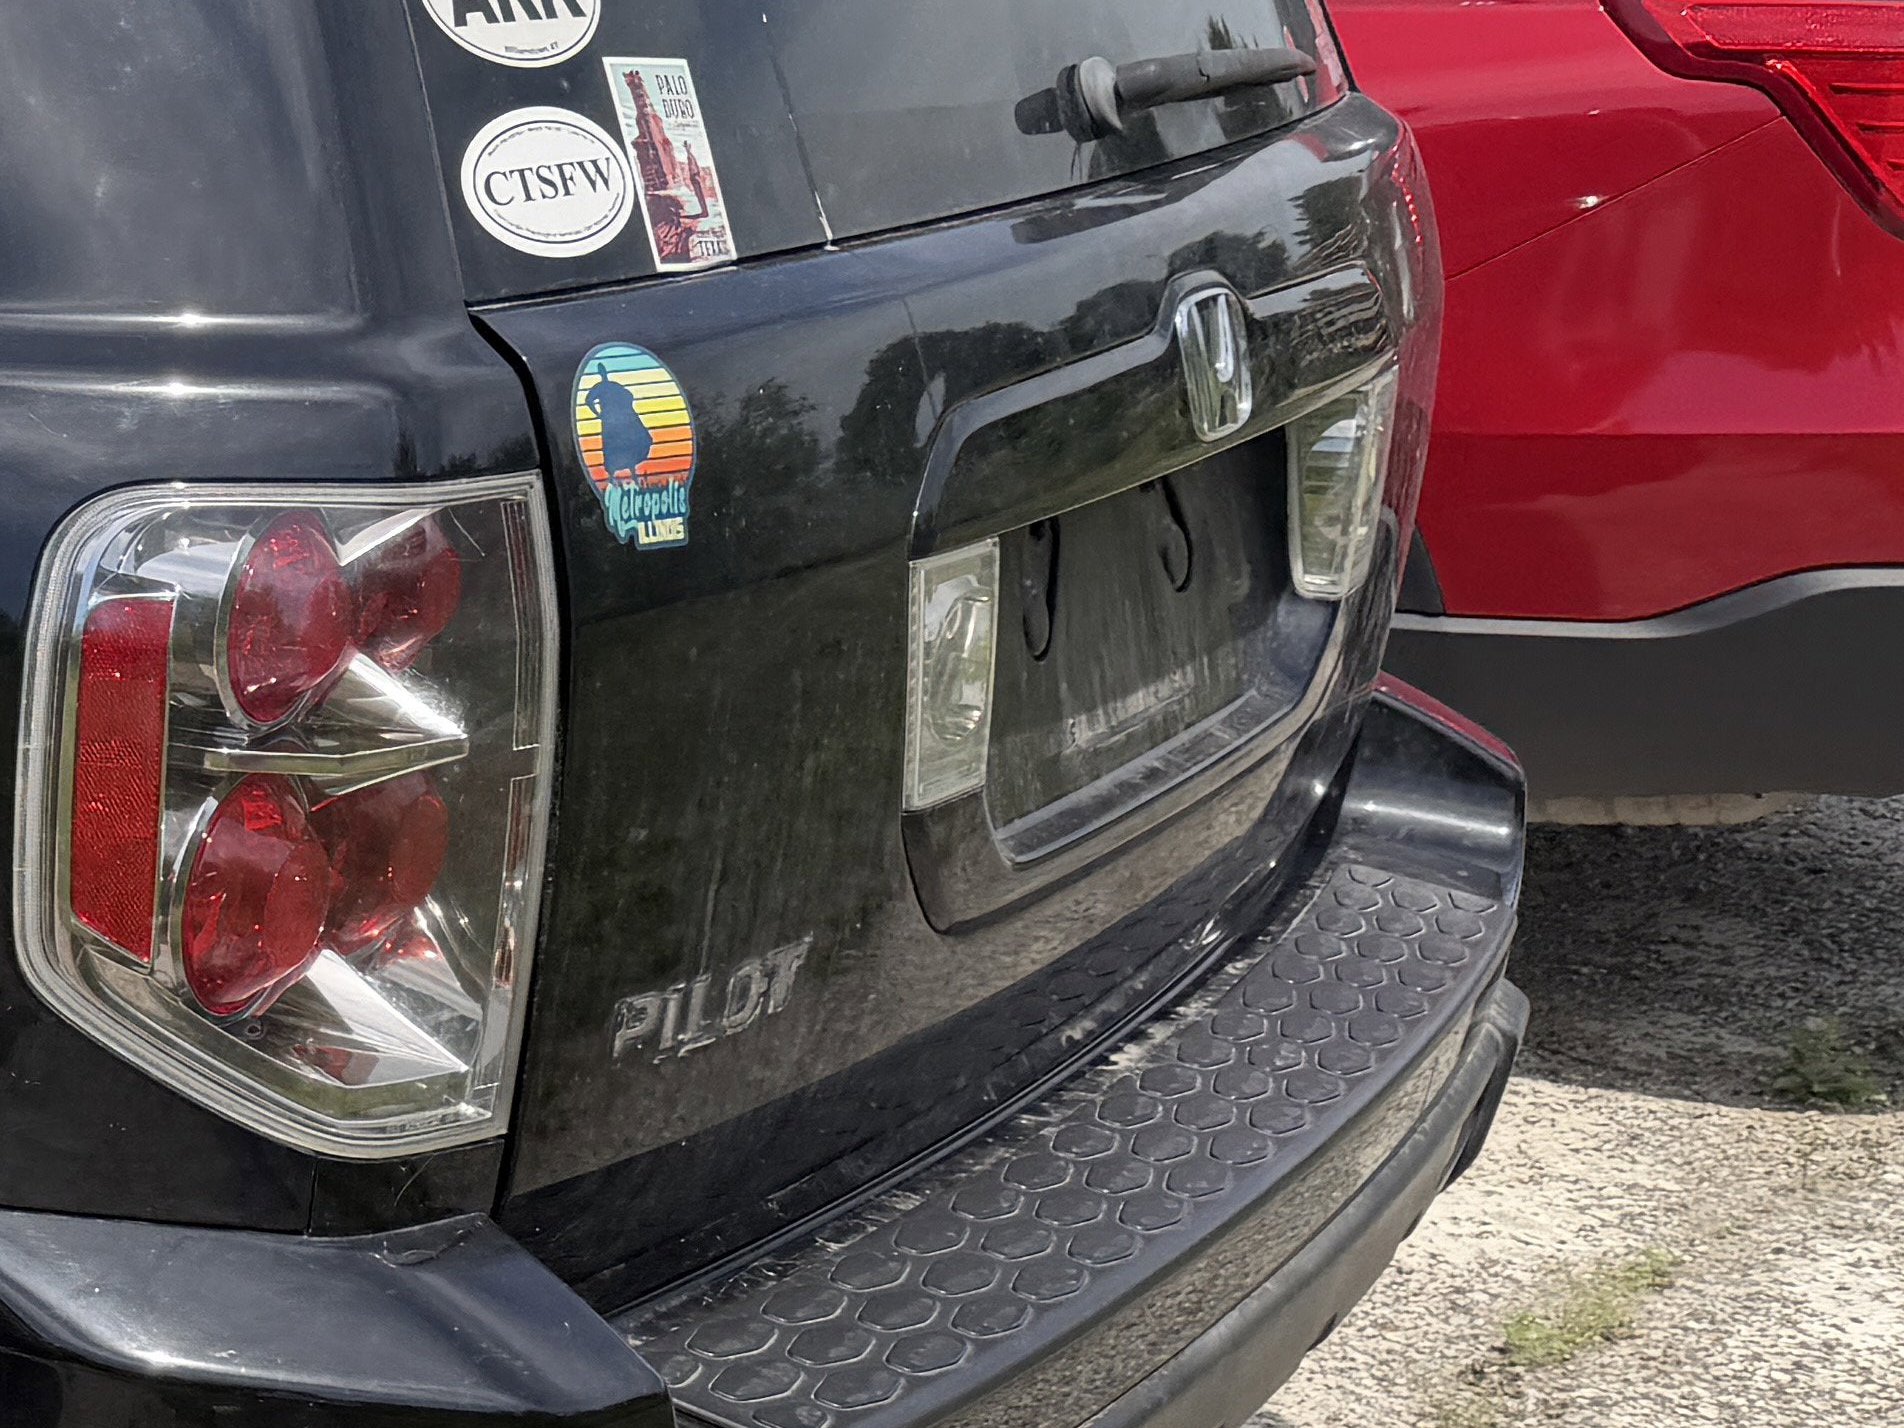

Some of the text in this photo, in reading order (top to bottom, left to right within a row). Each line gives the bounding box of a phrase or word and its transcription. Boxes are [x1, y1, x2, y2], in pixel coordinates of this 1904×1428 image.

[655, 74, 688, 96] PALO
[663, 98, 695, 120] DURO
[484, 156, 611, 207] CTSFW
[605, 476, 687, 538] Metropolis
[611, 930, 814, 1065] PILOT
